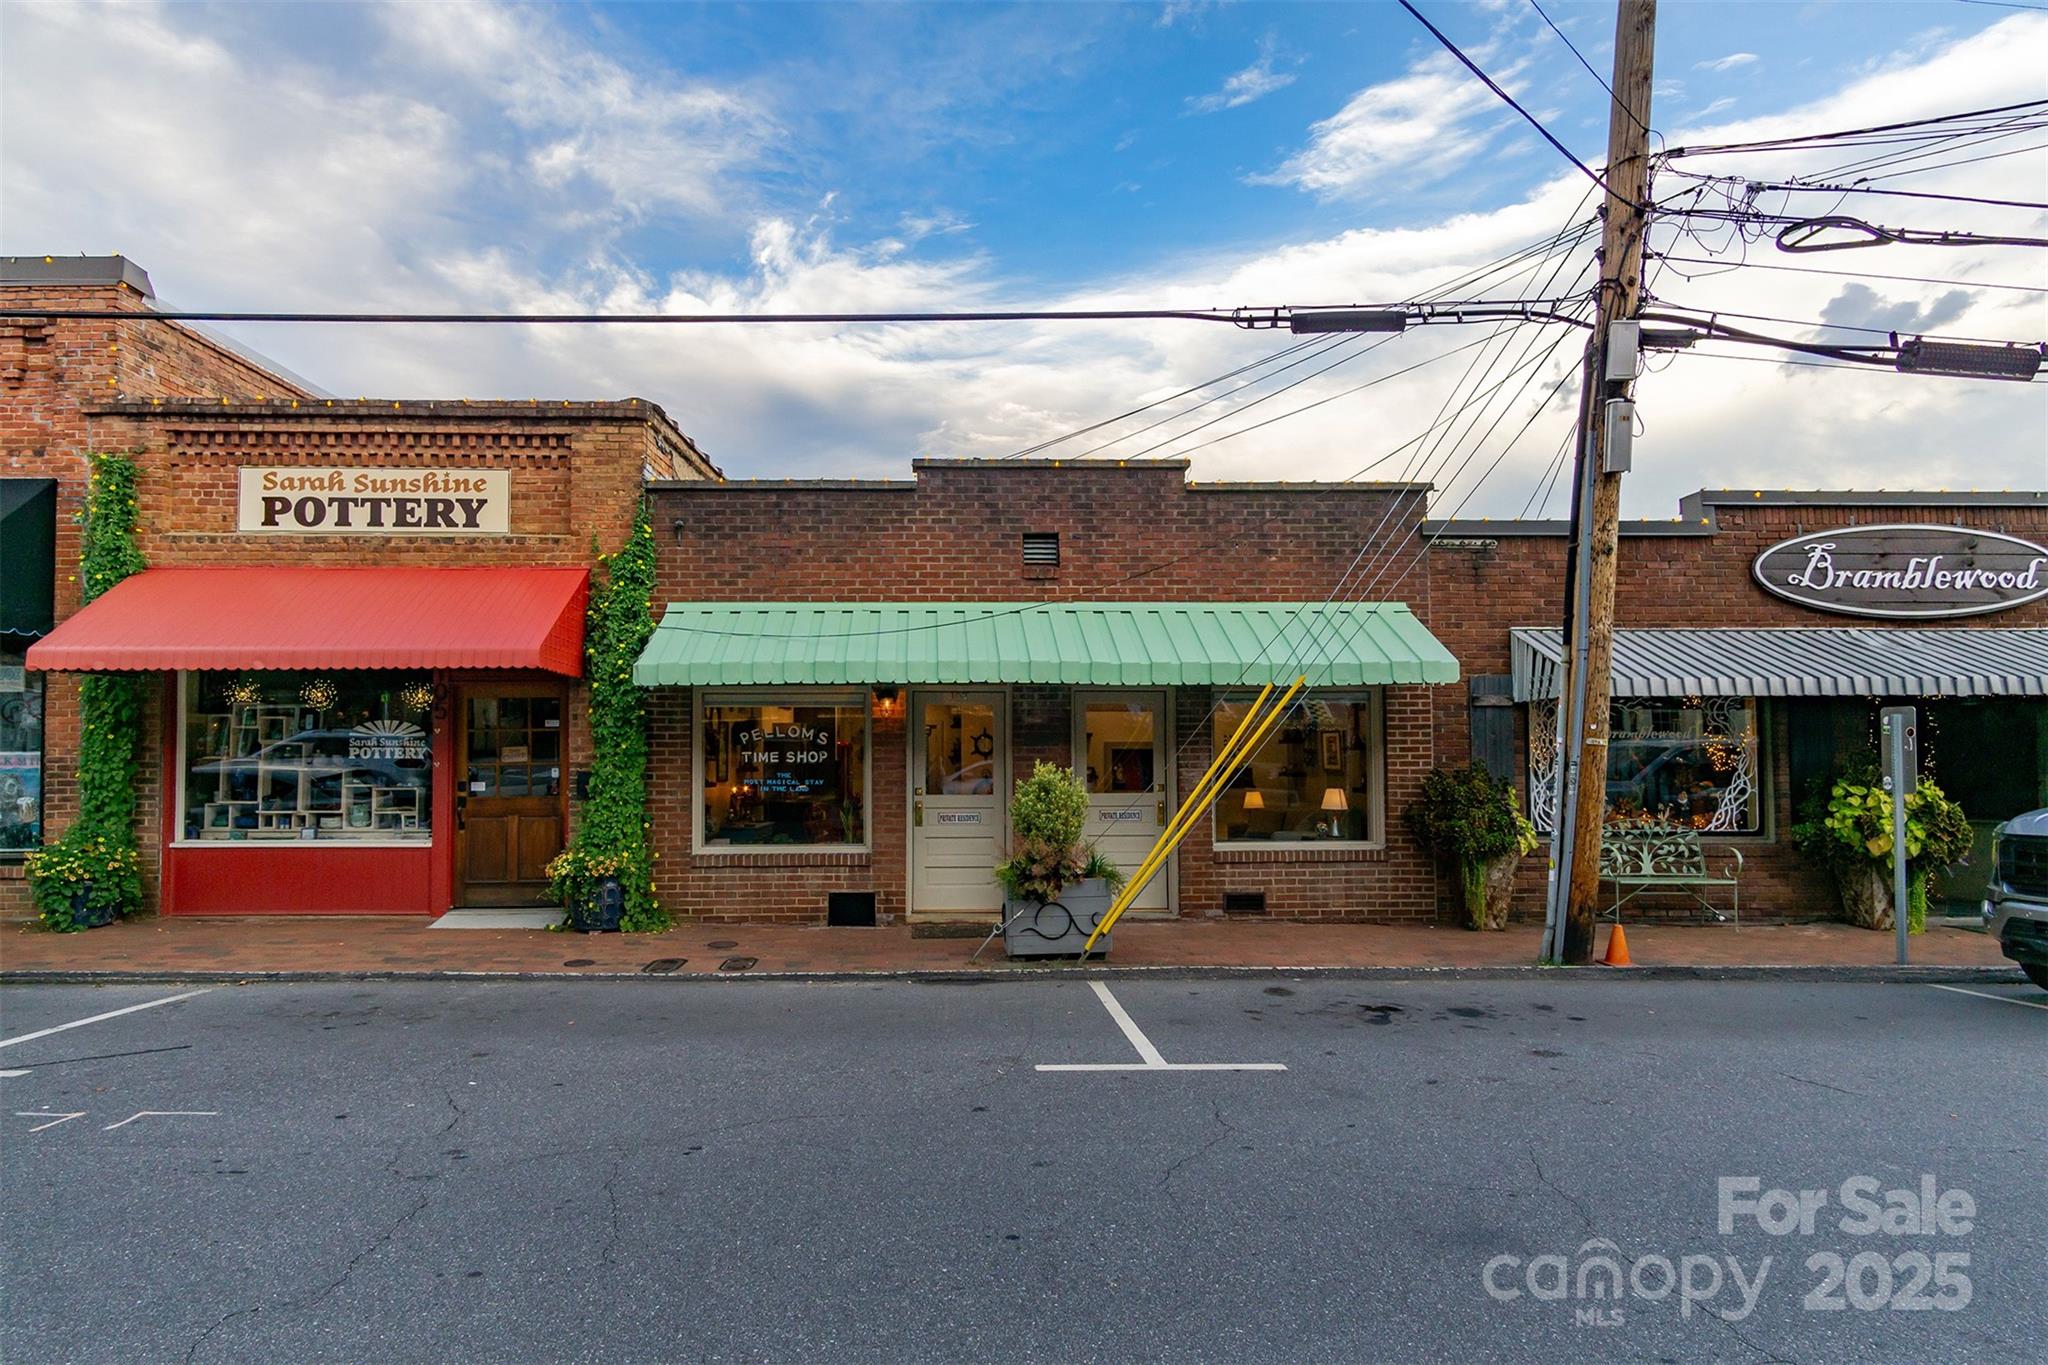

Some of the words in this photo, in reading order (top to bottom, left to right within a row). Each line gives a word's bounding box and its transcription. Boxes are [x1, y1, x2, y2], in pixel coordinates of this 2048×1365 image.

[262, 470, 346, 492] Sarah
[353, 471, 488, 494] Sunshine
[261, 496, 488, 528] POTTERY
[1787, 543, 2047, 590] Bramblewood
[739, 725, 829, 745] PELLOMS
[1608, 725, 1694, 739] ramblewood
[349, 736, 378, 747] Sarah
[379, 737, 426, 748] Sunshine
[348, 747, 427, 760] POTTERY
[741, 751, 779, 763] TIME
[785, 750, 828, 764] SHOP
